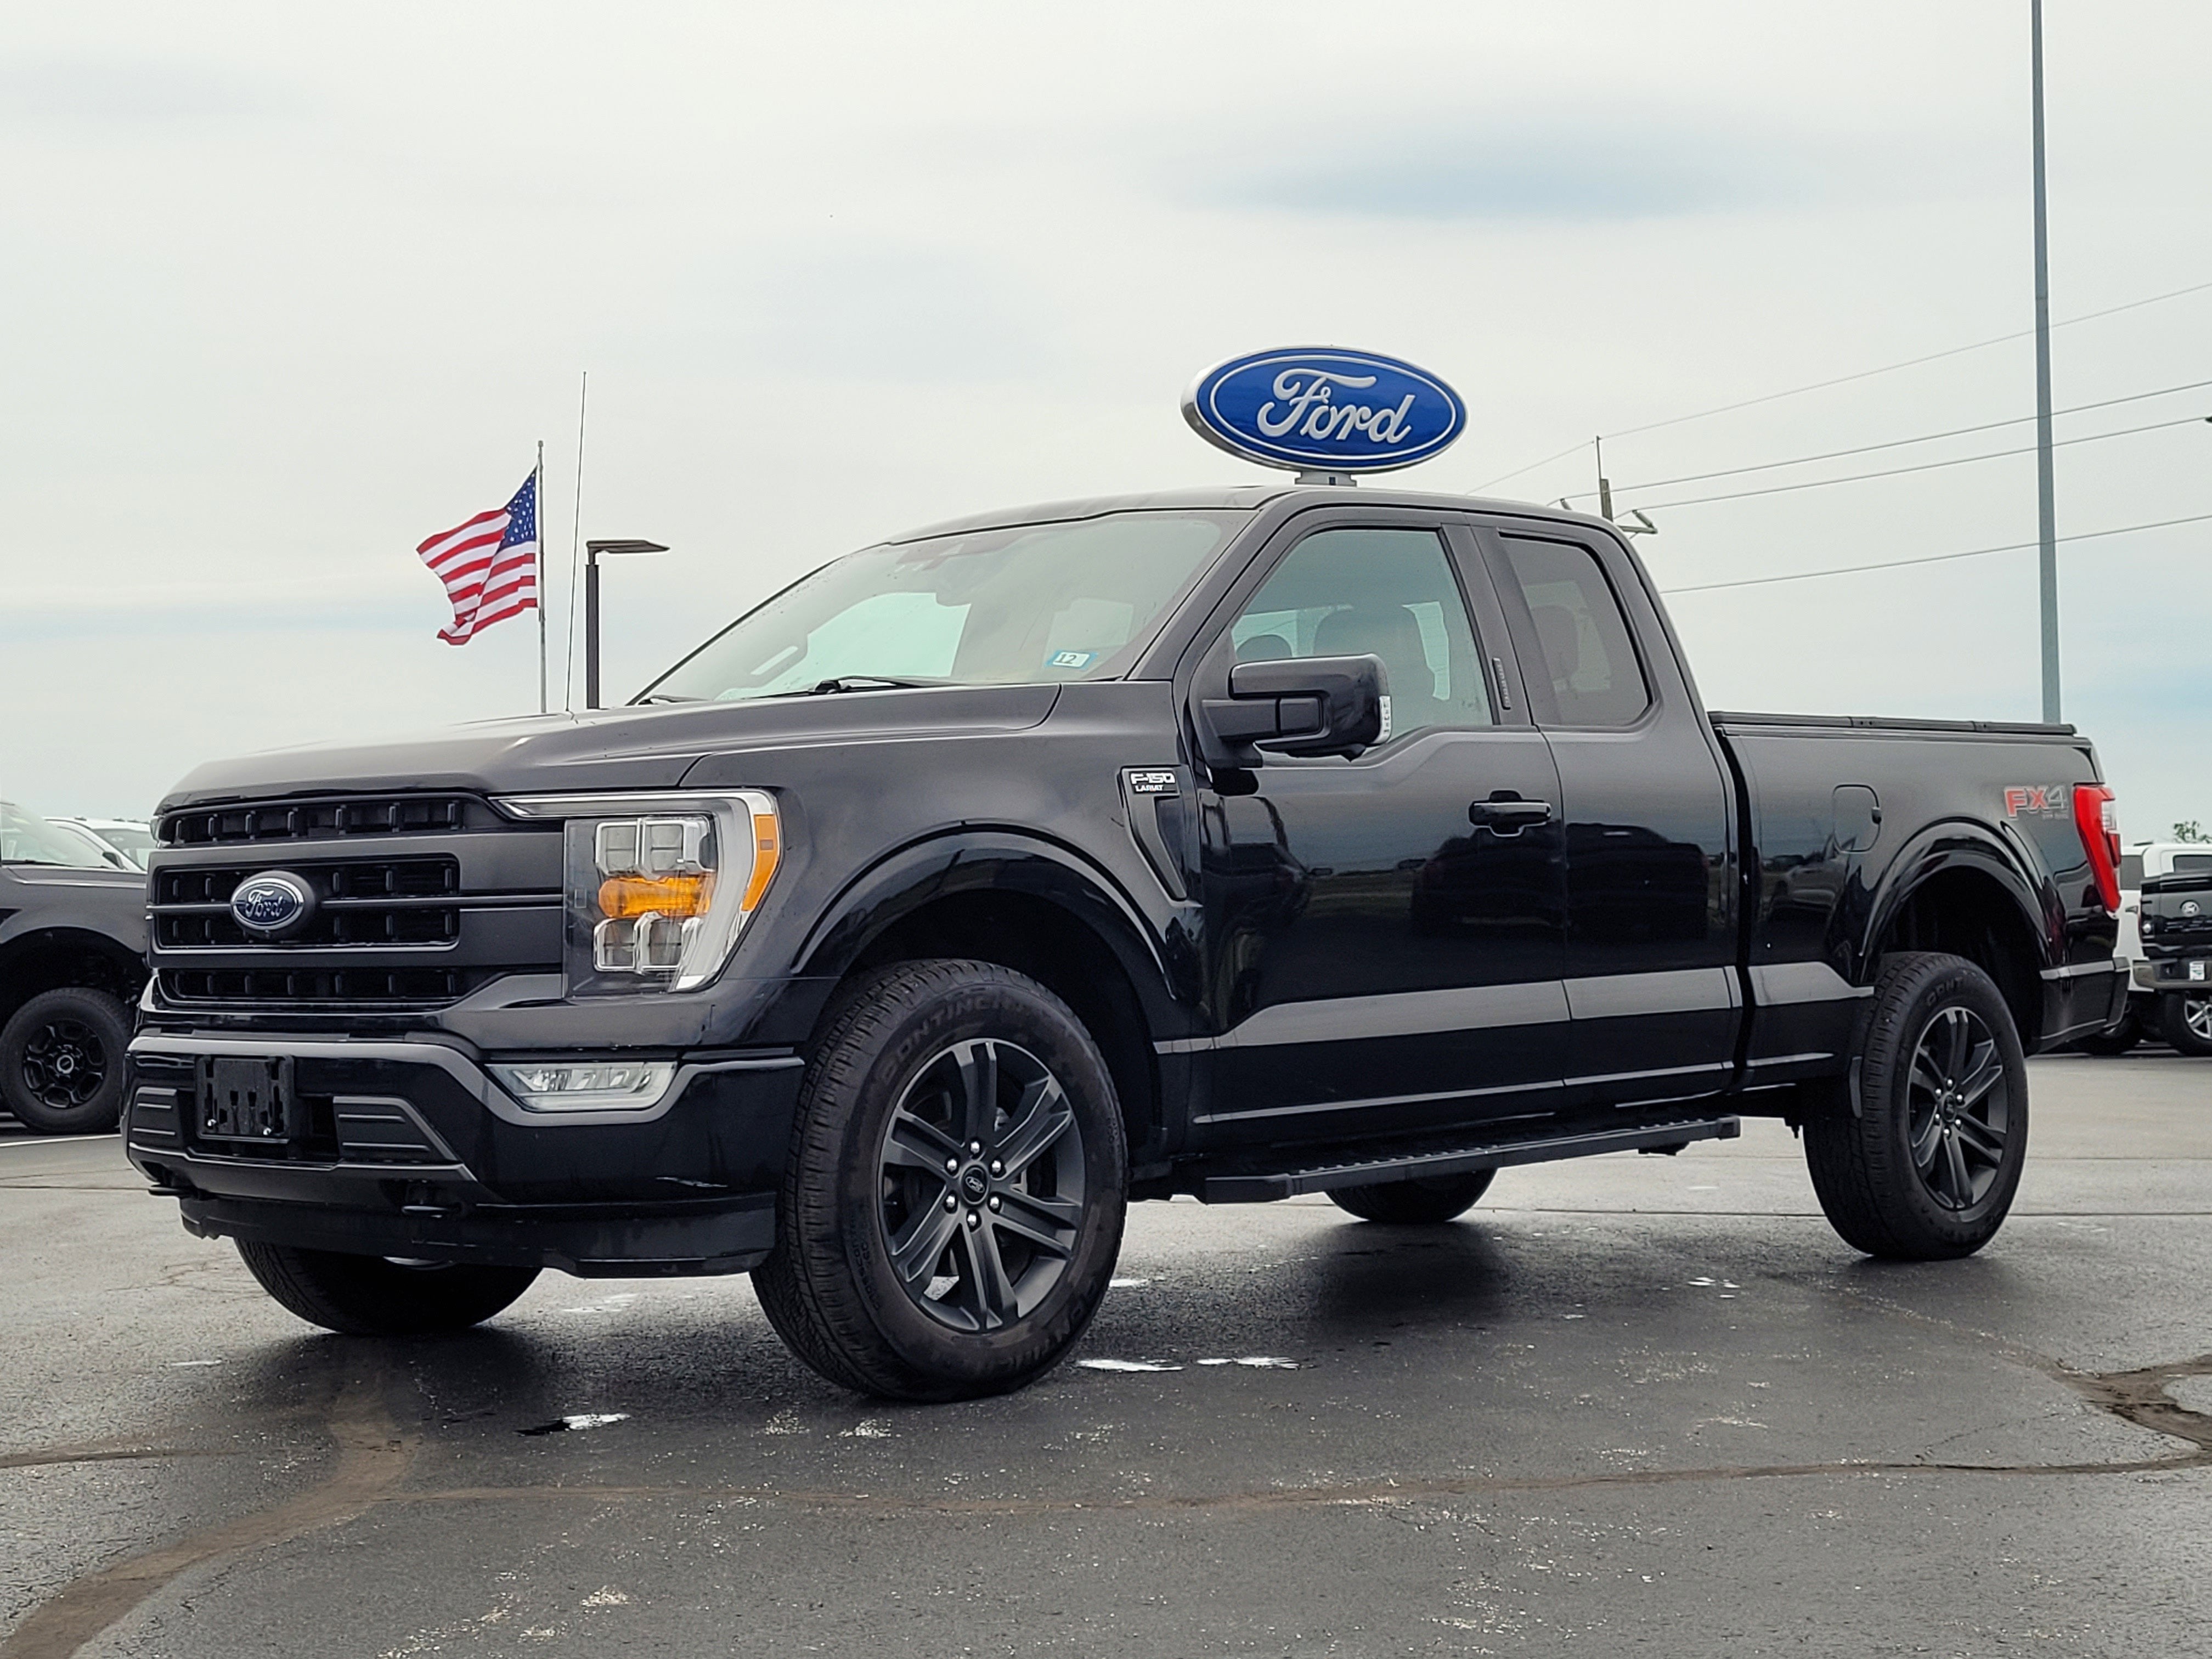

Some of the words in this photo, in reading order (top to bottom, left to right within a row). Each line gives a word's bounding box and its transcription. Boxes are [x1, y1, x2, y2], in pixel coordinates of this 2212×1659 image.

[1256, 368, 1416, 444] Ford
[1055, 653, 1077, 664] 12
[1131, 772, 1175, 785] F-150
[2004, 785, 2068, 817] FX4
[245, 889, 283, 917] Ford
